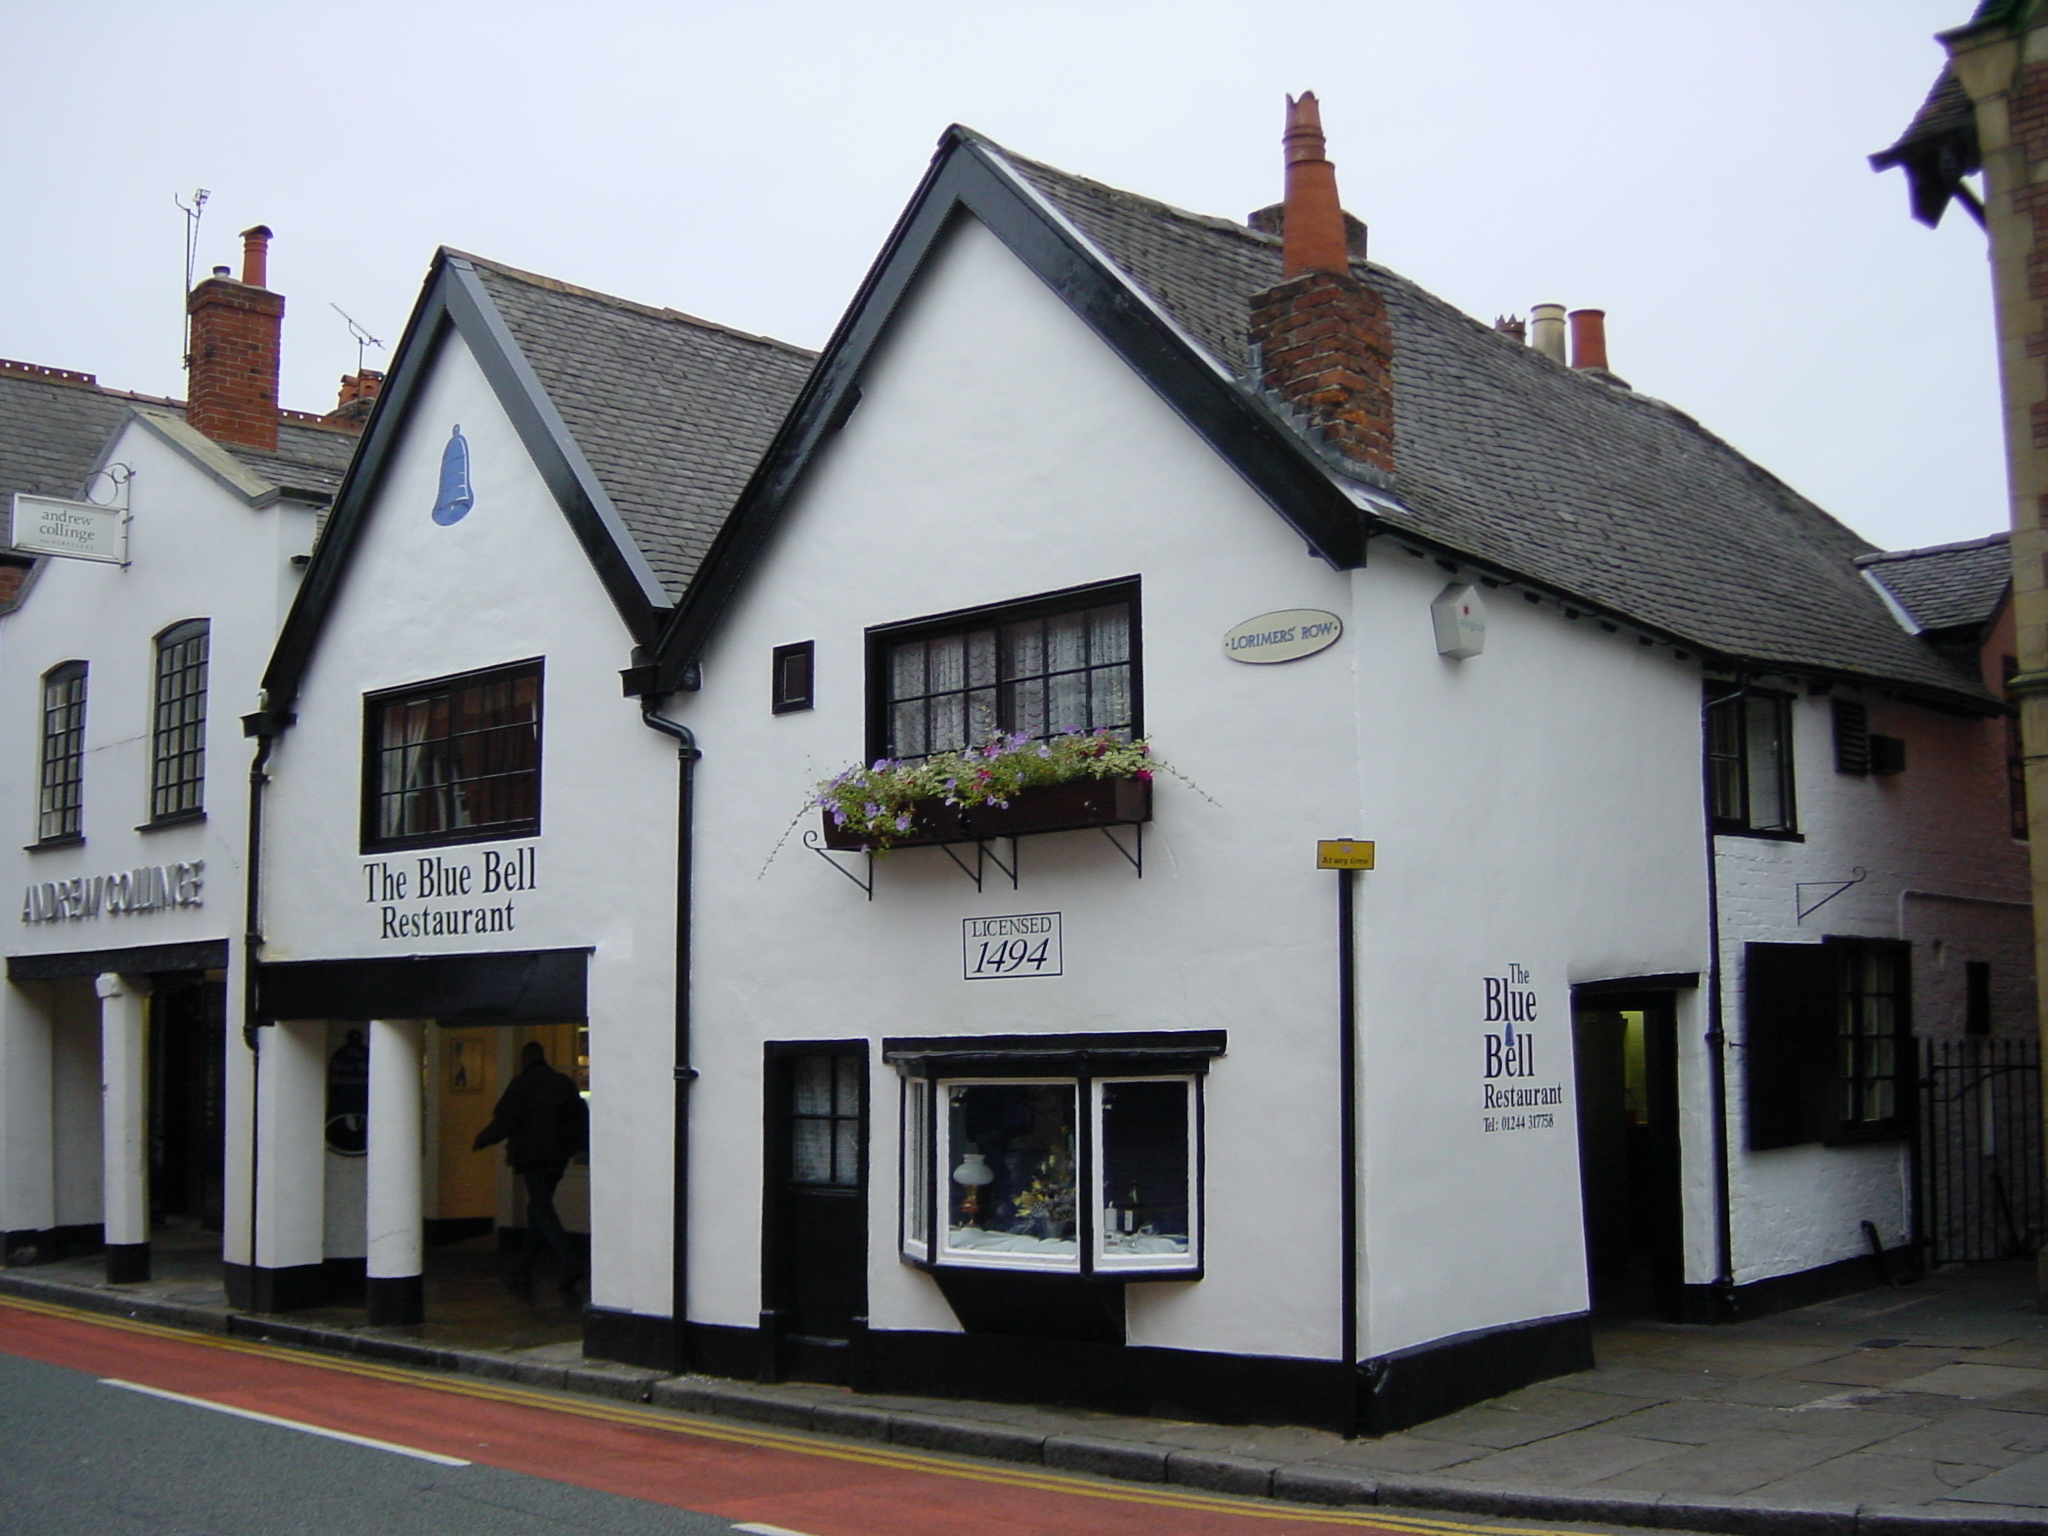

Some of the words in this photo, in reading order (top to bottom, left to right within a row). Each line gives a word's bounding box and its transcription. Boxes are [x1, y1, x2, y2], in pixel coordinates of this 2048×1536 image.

[41, 510, 93, 526] andrew
[39, 523, 95, 543] collinge
[1301, 622, 1334, 640] ROW
[363, 862, 407, 903] The
[416, 857, 472, 899] Blue
[482, 847, 537, 894] Bell
[21, 875, 104, 923] ANDREW
[380, 898, 515, 939] Restaurant
[971, 916, 1052, 937] LICENSED
[972, 938, 1050, 973] 1494
[1508, 963, 1530, 984] The
[1483, 977, 1538, 1022] Blue
[1484, 1034, 1535, 1079] Bell
[1483, 1082, 1562, 1109] Restaurant
[1483, 1116, 1499, 1132] Tel:
[1501, 1115, 1525, 1131] 01244
